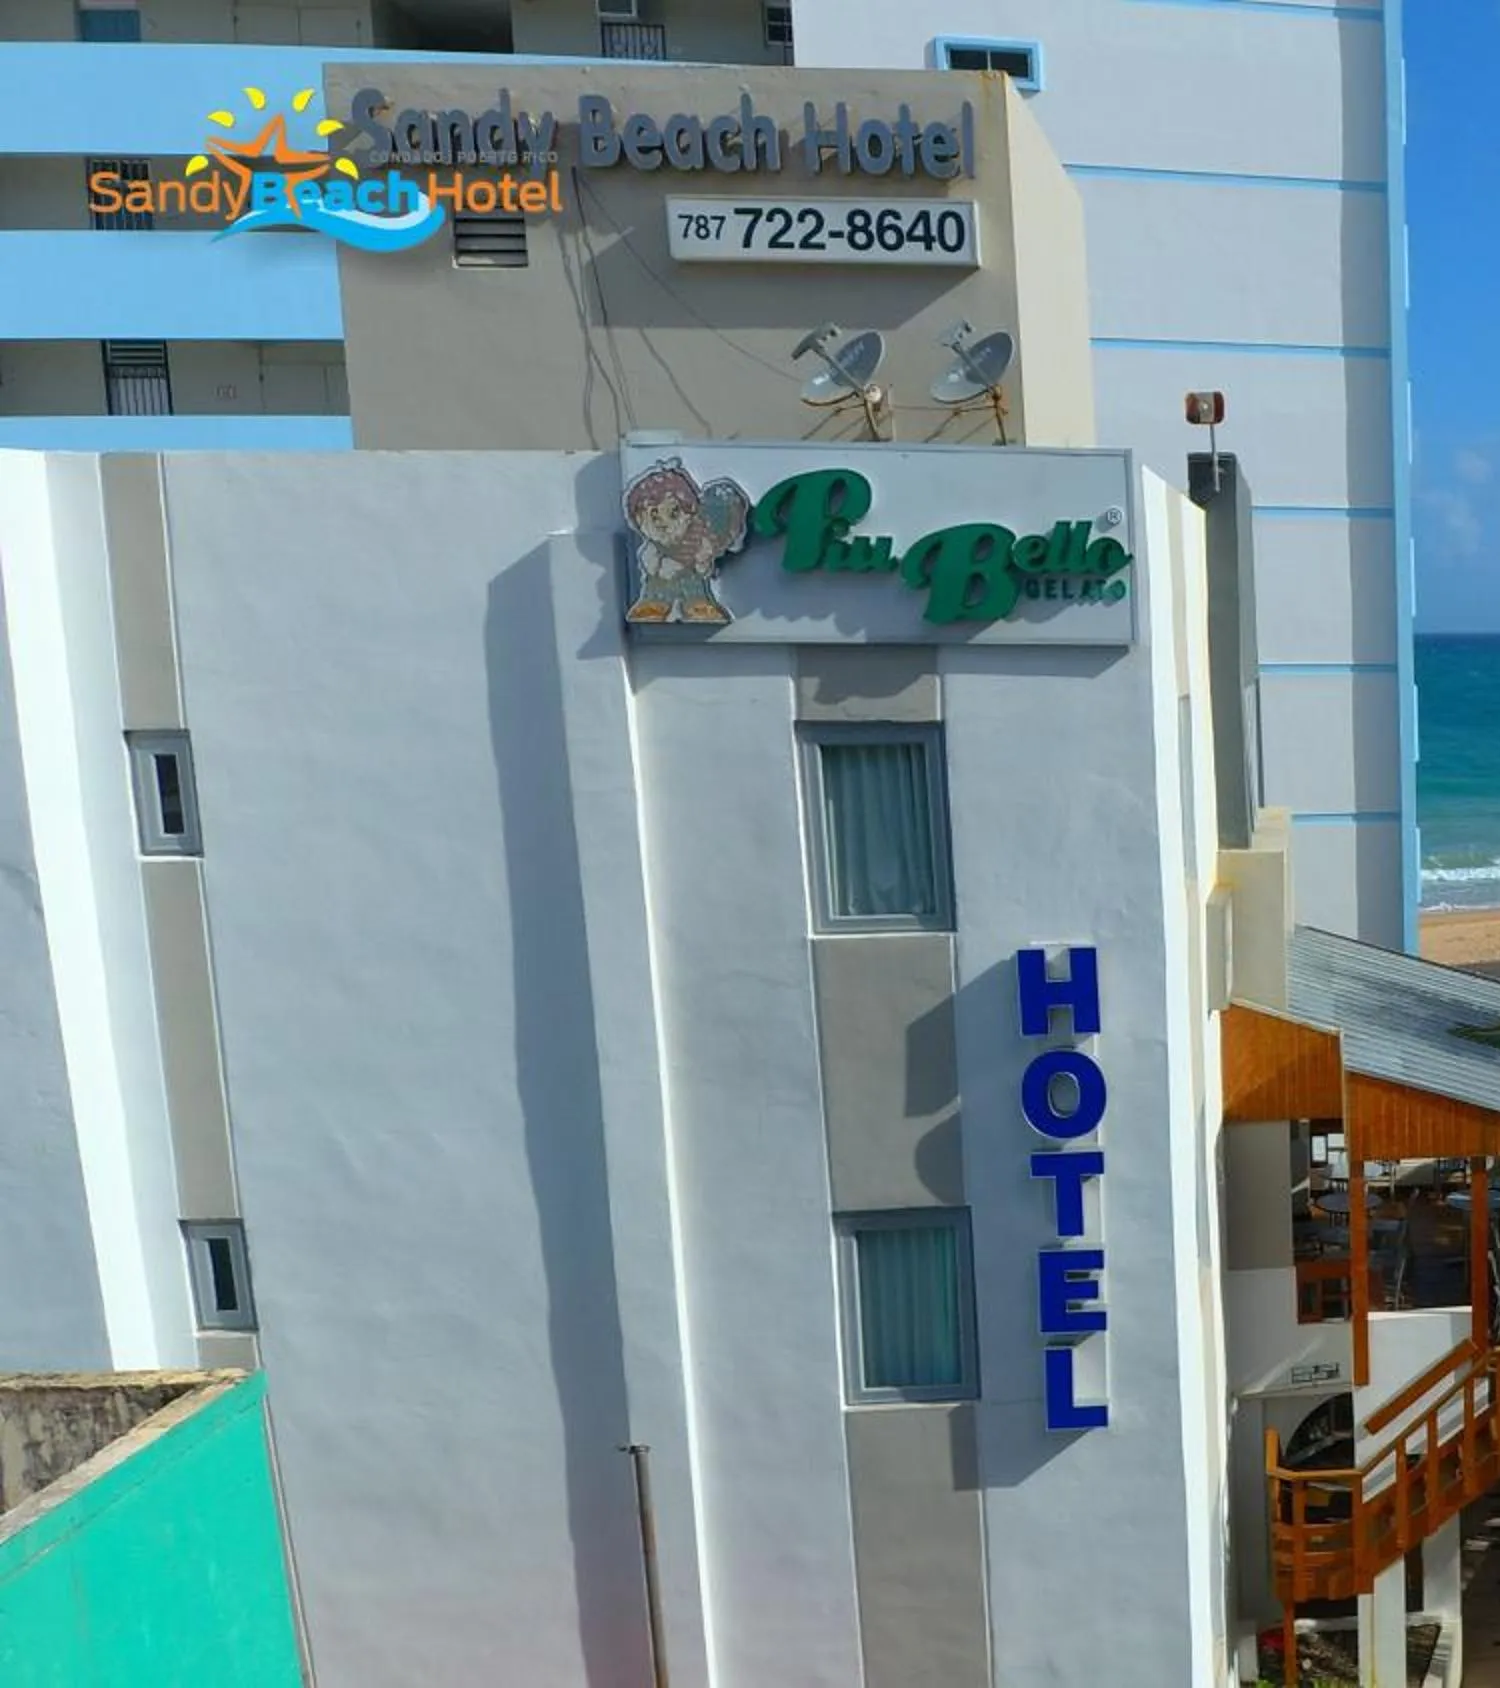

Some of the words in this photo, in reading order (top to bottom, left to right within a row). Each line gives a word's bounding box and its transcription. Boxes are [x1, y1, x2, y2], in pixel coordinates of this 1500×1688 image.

[352, 87, 557, 182] Sandy
[579, 94, 781, 172] Beach
[804, 101, 975, 179] Hotel
[677, 214, 727, 240] 787
[733, 207, 965, 252] 722-8640
[900, 523, 1133, 625] Bello
[1025, 579, 1126, 600] GELATO
[1016, 946, 1109, 1429] HOTEL
